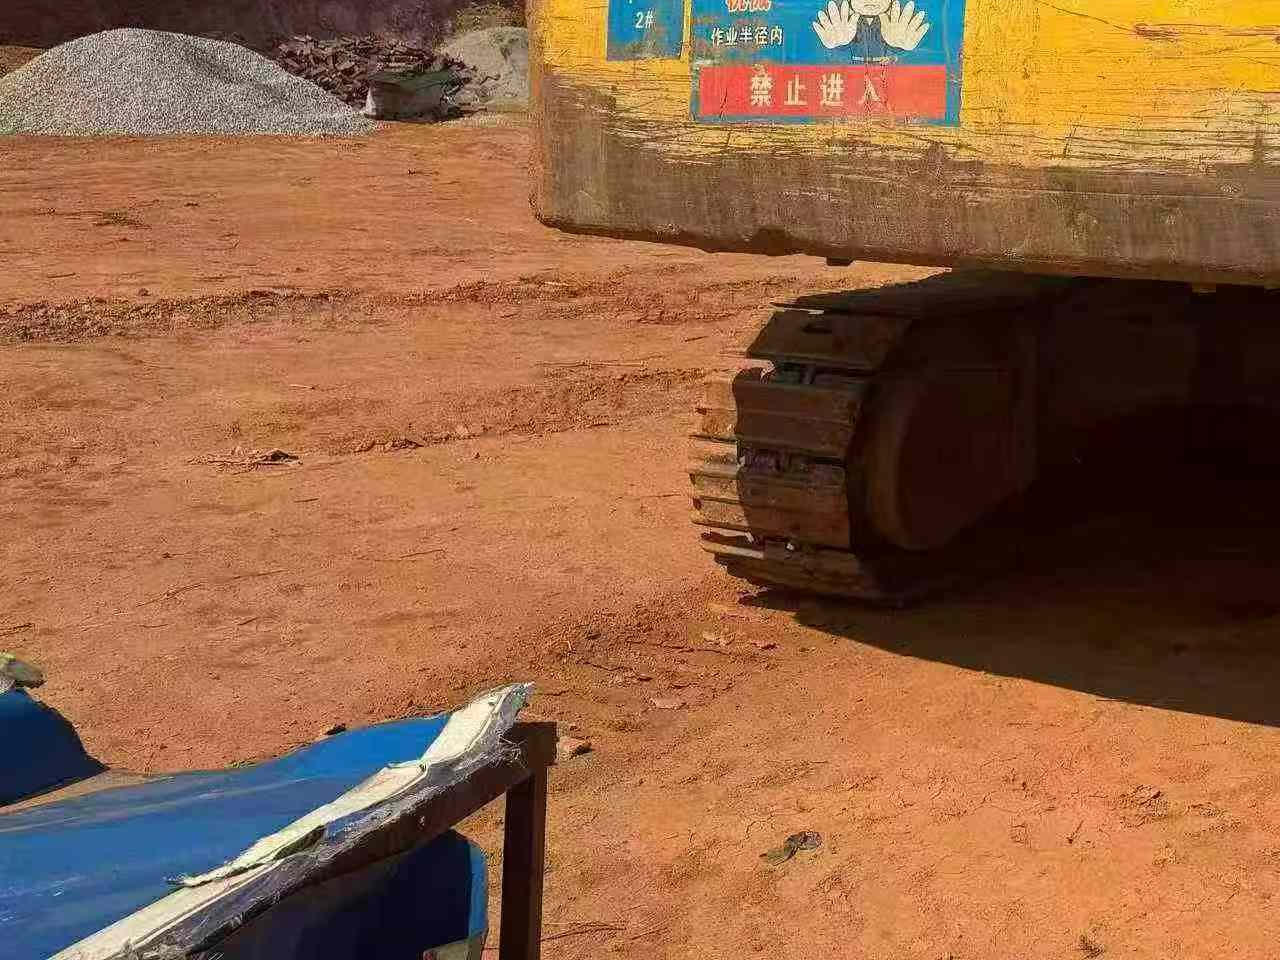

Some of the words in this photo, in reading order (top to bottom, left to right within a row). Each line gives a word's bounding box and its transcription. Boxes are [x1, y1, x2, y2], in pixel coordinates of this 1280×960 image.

[711, 25, 783, 47] 作业半径内
[750, 64, 882, 107] 禁止进入
